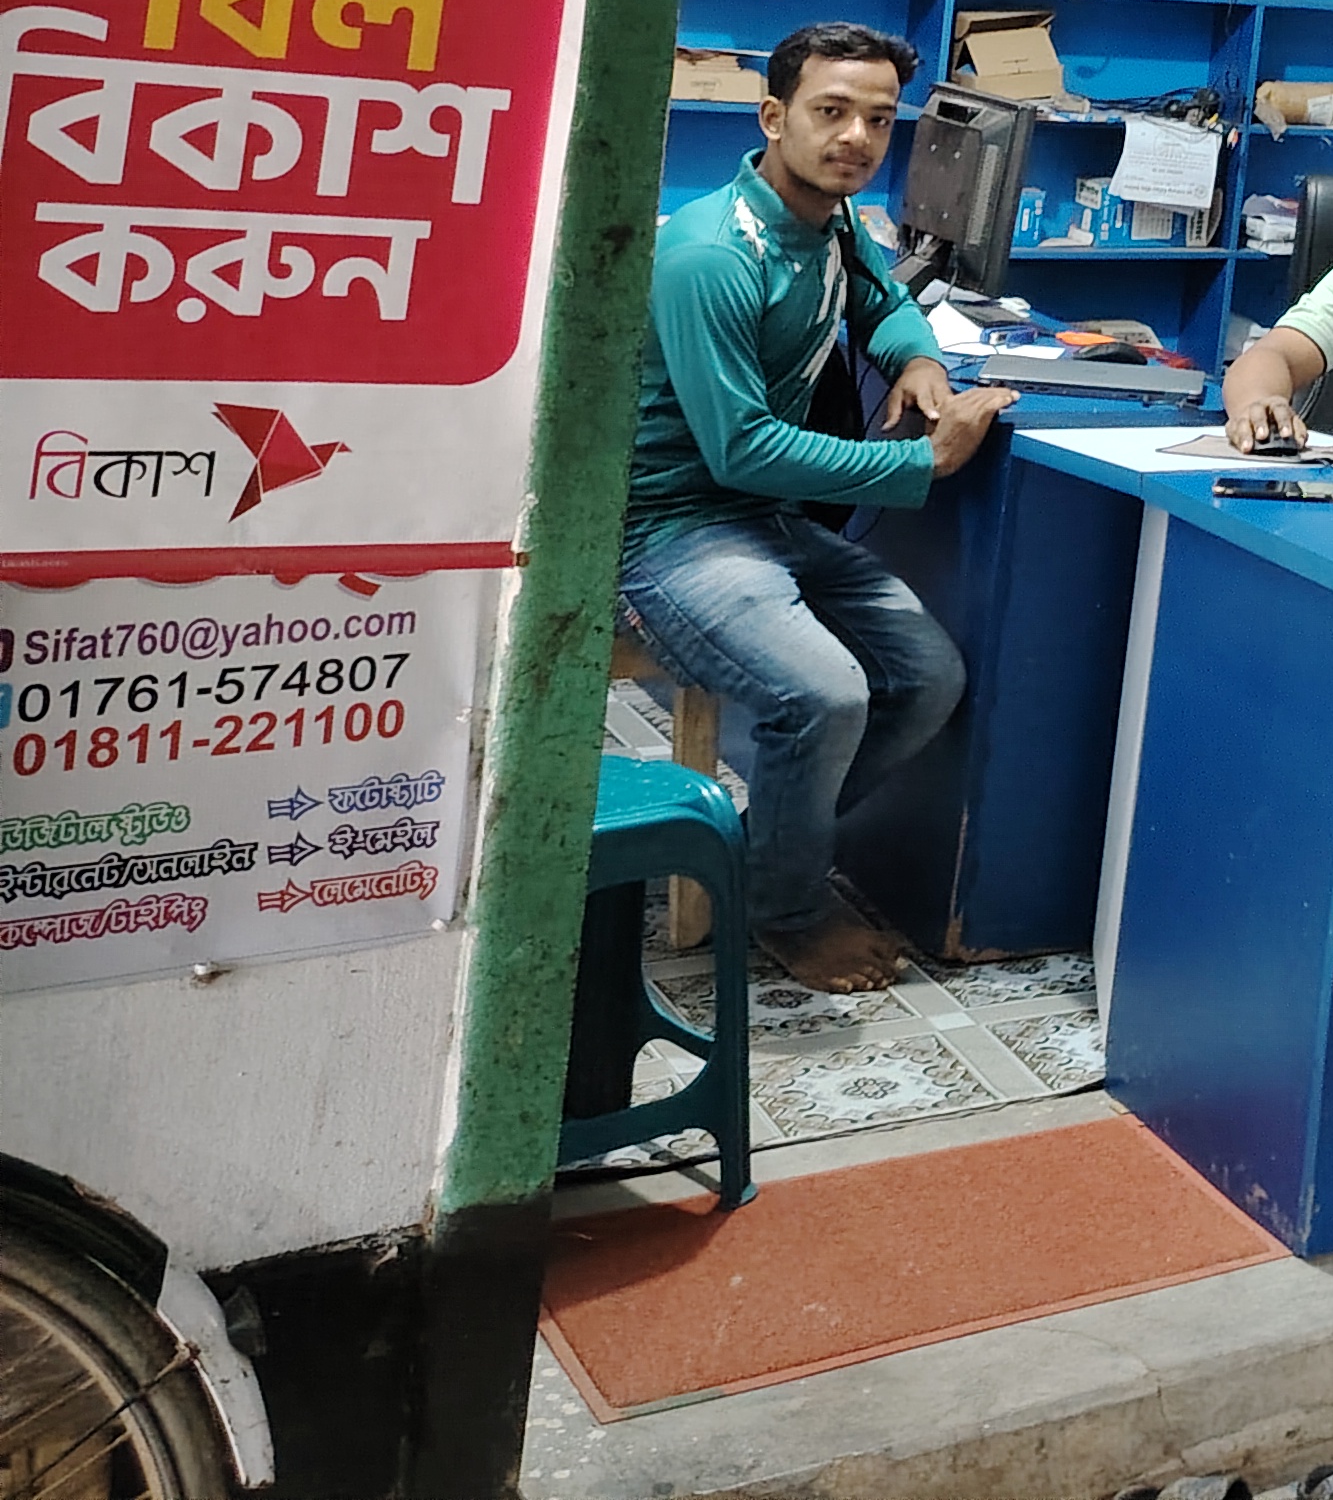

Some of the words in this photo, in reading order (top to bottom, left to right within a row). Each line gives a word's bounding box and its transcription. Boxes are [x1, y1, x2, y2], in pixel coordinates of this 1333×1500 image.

[0, 5, 511, 205] বিকাশ
[35, 202, 432, 323] করুন
[29, 430, 217, 500] বিকাশ
[22, 610, 417, 666] Sifat760@yahoo.com
[17, 653, 411, 723] 01761-574807
[13, 700, 405, 776] 01811-221100
[329, 817, 440, 858] ই-মেইল
